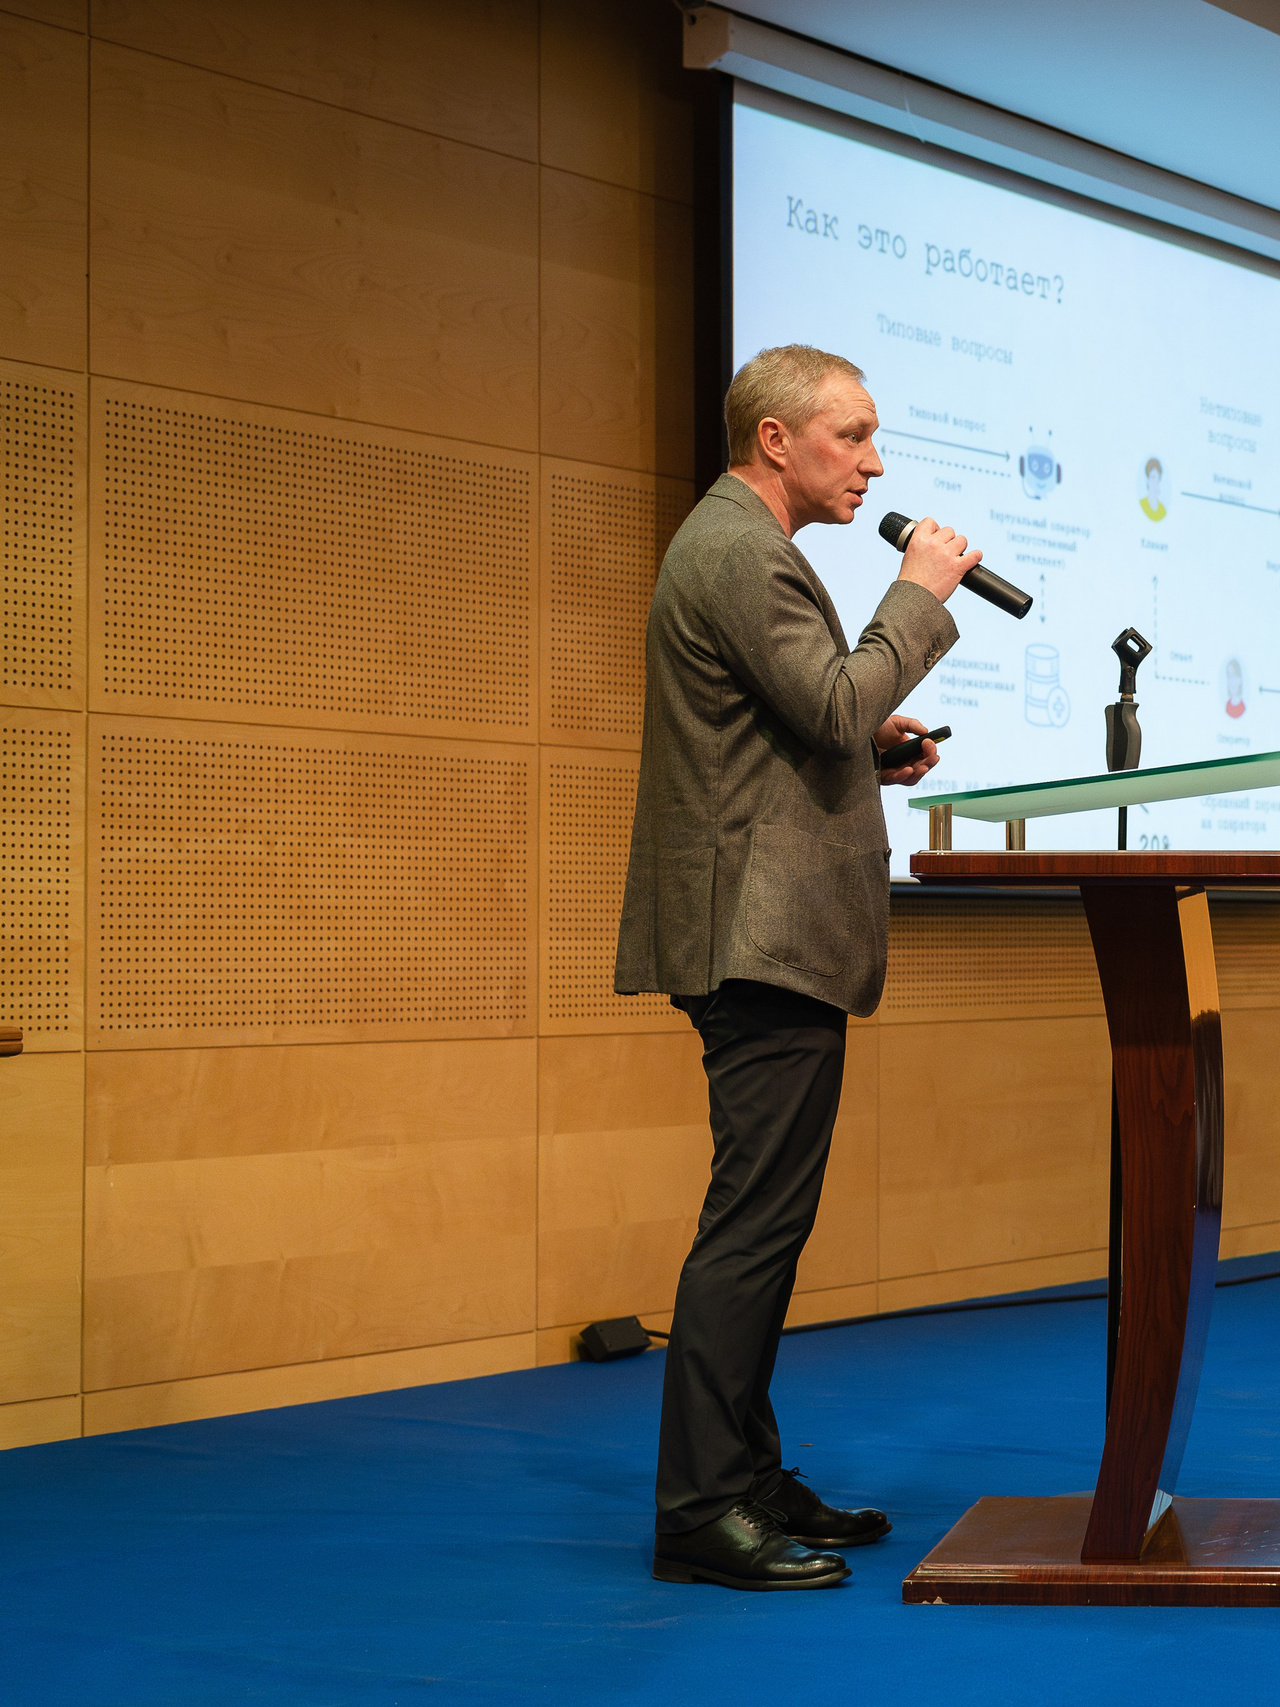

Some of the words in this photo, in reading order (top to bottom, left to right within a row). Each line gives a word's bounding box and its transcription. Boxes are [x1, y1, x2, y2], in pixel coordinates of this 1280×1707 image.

[786, 195, 839, 240] Как
[857, 223, 907, 259] это
[924, 241, 1065, 305] работает?
[876, 312, 942, 347] Типовые
[951, 335, 1014, 366] вопросы
